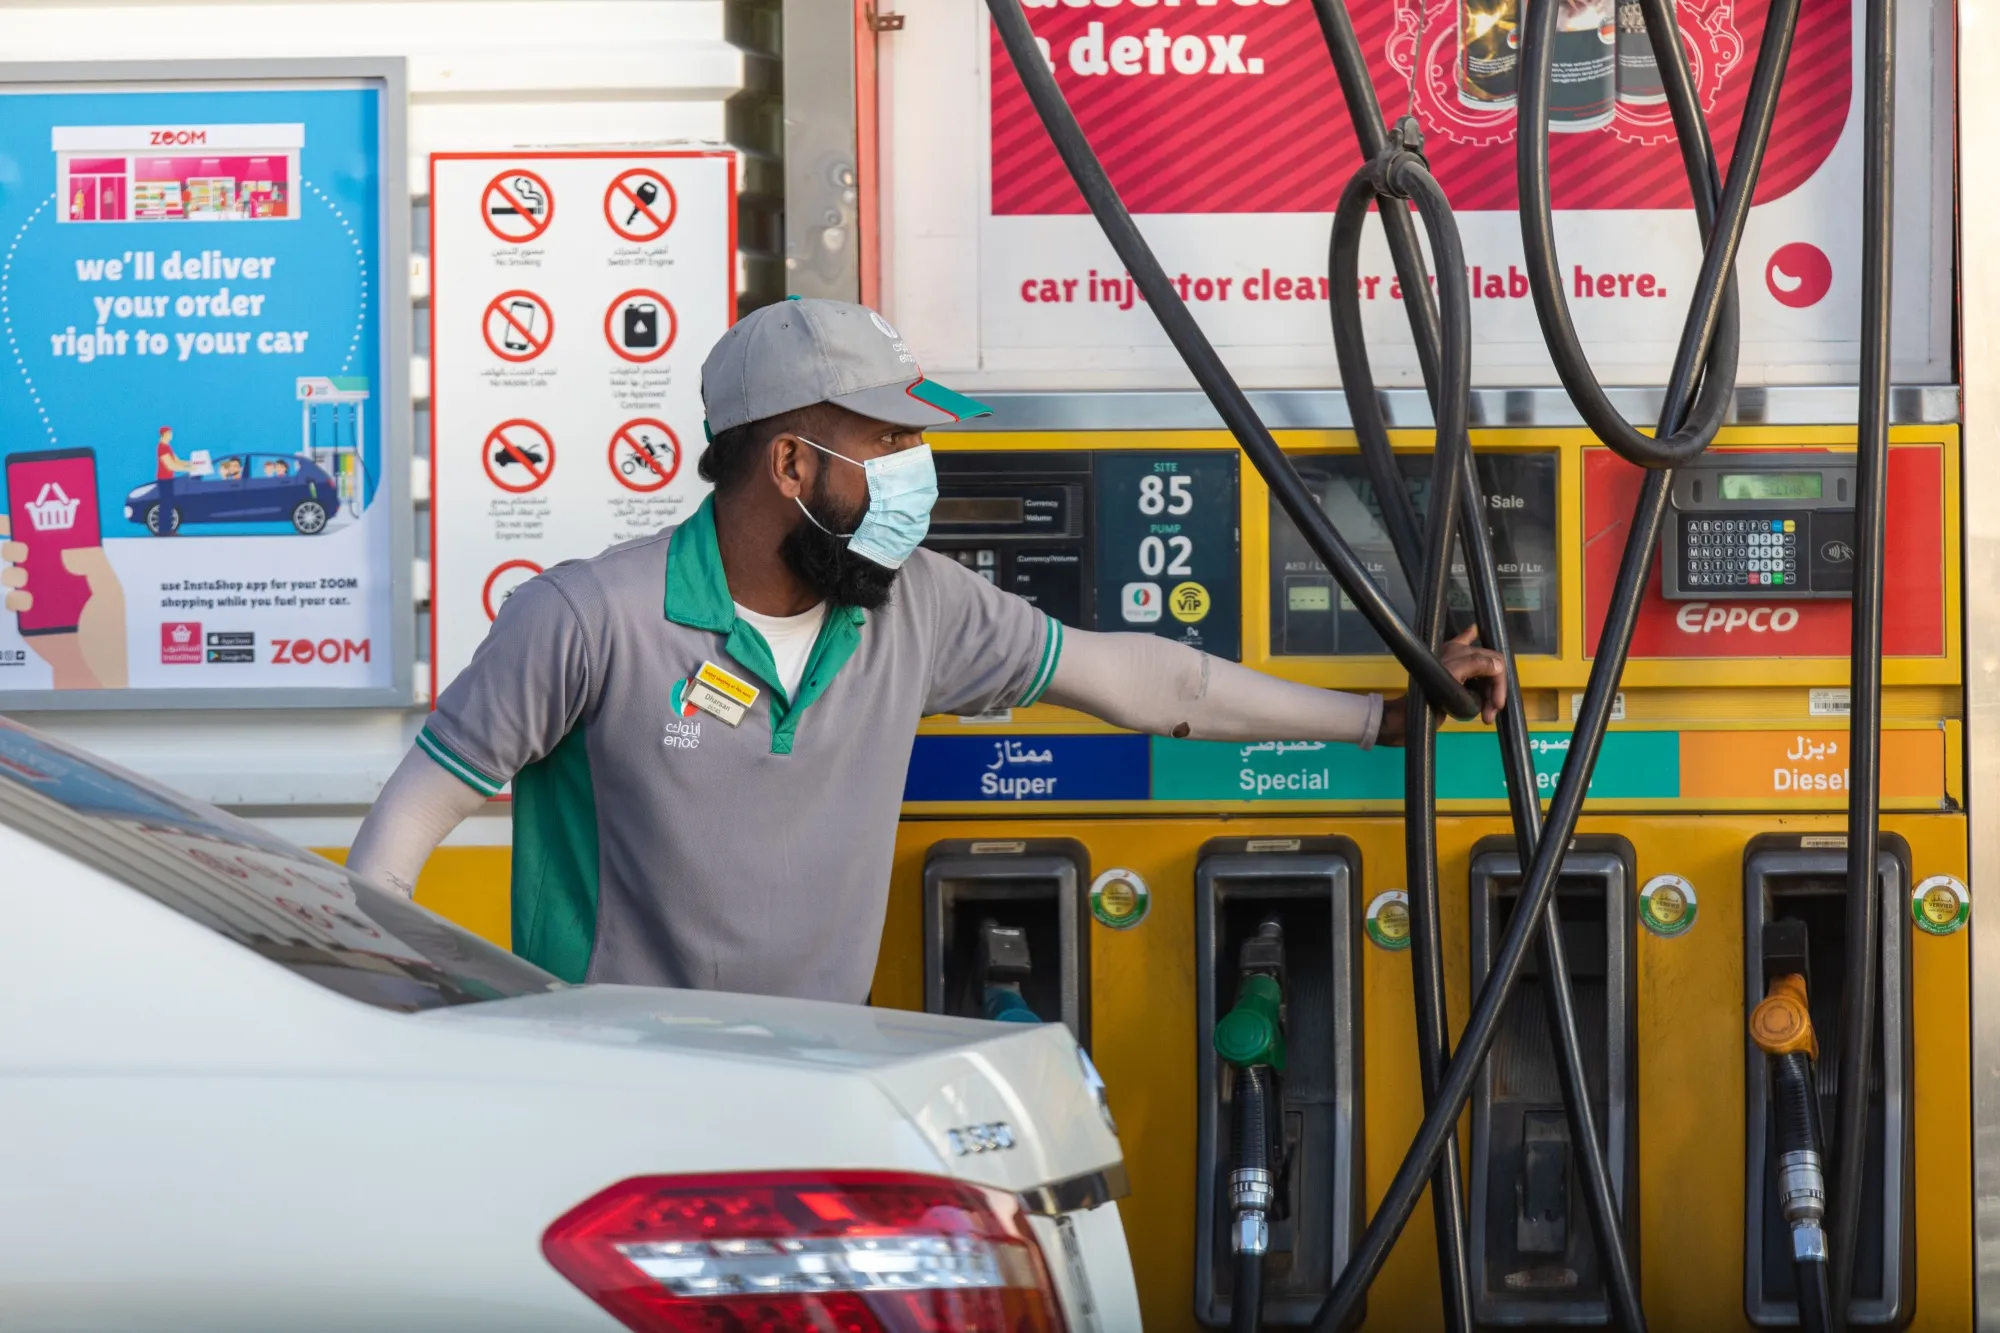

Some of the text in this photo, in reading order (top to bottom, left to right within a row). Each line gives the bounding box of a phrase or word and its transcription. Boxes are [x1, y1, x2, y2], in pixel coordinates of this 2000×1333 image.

[1068, 21, 1264, 76] detox.
[150, 131, 206, 145] ZOOM
[76, 250, 275, 281] we'll deliver
[508, 259, 542, 267] Smoking
[649, 258, 674, 267] Engine
[1020, 277, 1079, 303] car
[1088, 269, 1233, 311] injtor
[1242, 268, 1380, 301] clear
[1573, 265, 1667, 298] here.
[94, 288, 265, 324] your order
[51, 327, 308, 362] right to your car
[1154, 463, 1178, 472] SITE
[1138, 475, 1193, 515] 85
[1491, 495, 1524, 508] Sale
[1025, 500, 1058, 508] Currency
[1151, 524, 1181, 534] PUMP
[1138, 536, 1193, 575] 02
[1285, 562, 1305, 570] AED
[1367, 562, 1386, 571] Ltr.
[1451, 564, 1465, 572] ED
[1497, 564, 1517, 572] AED
[161, 578, 358, 593] use InstaShop app for your ZOOM
[161, 596, 350, 609] shopping while you fuel your car.
[271, 638, 370, 664] ZOOM
[664, 736, 699, 748] enoc
[1787, 736, 1838, 760] ديزل
[986, 740, 1052, 769] ممتاز
[981, 773, 1057, 799] Super
[1239, 768, 1329, 796] Special
[1774, 768, 1849, 791] Diesel
